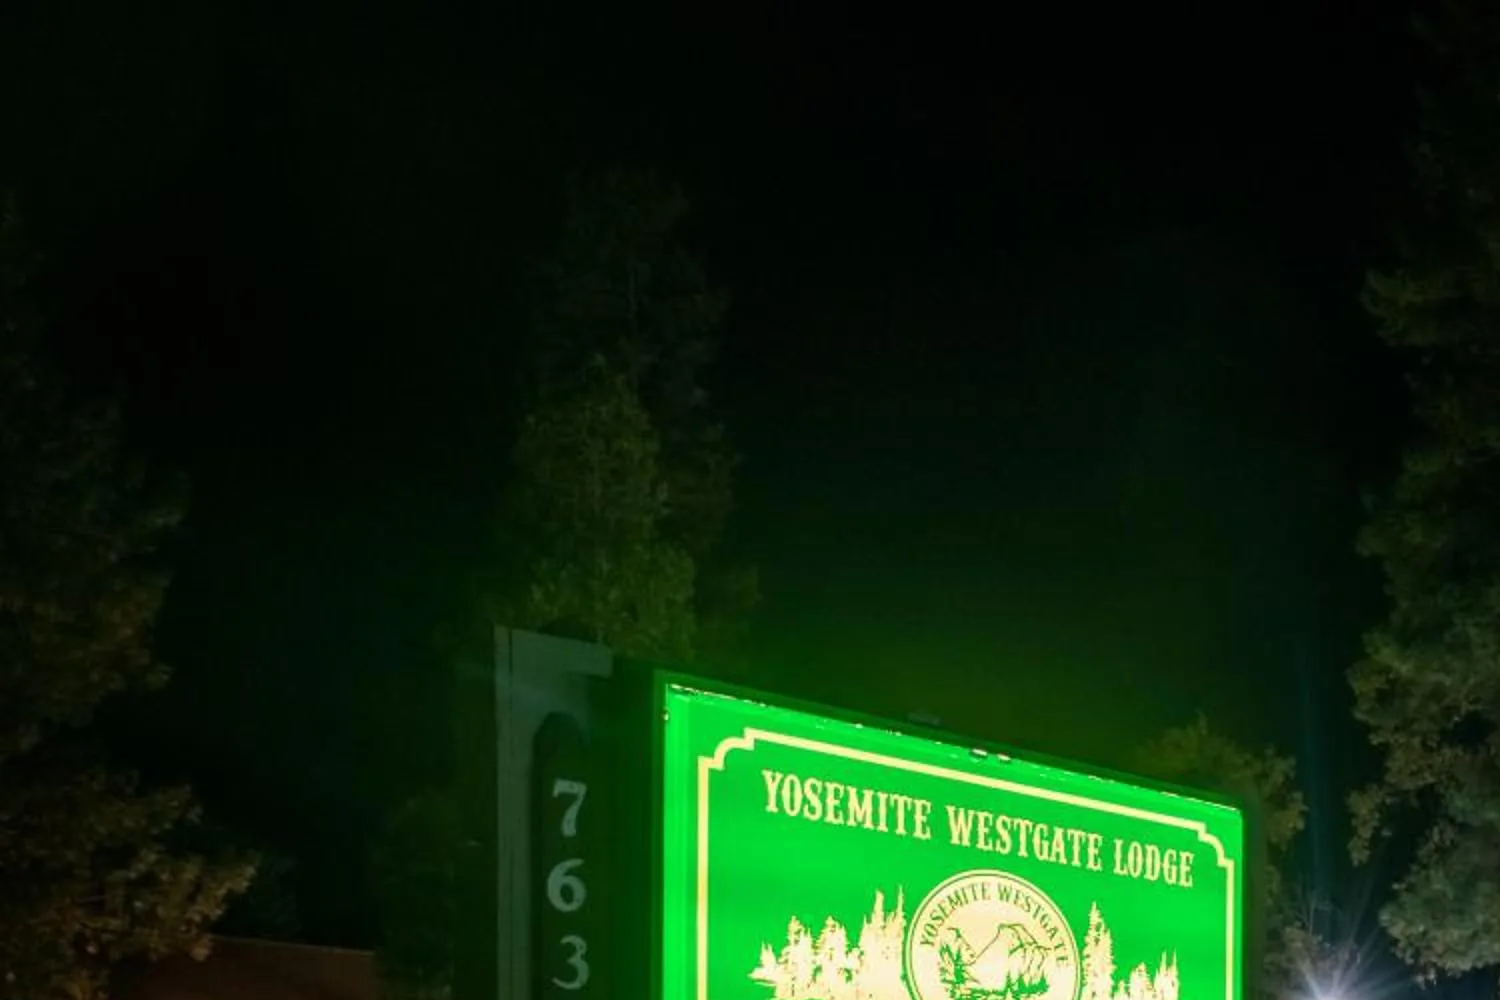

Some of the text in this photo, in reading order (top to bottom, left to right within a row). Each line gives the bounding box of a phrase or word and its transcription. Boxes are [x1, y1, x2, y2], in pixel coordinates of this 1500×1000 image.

[762, 770, 1194, 887] YOSEMITE WESTGATE LODGE
[920, 882, 1069, 967] YOSEMITE WESTGATE
